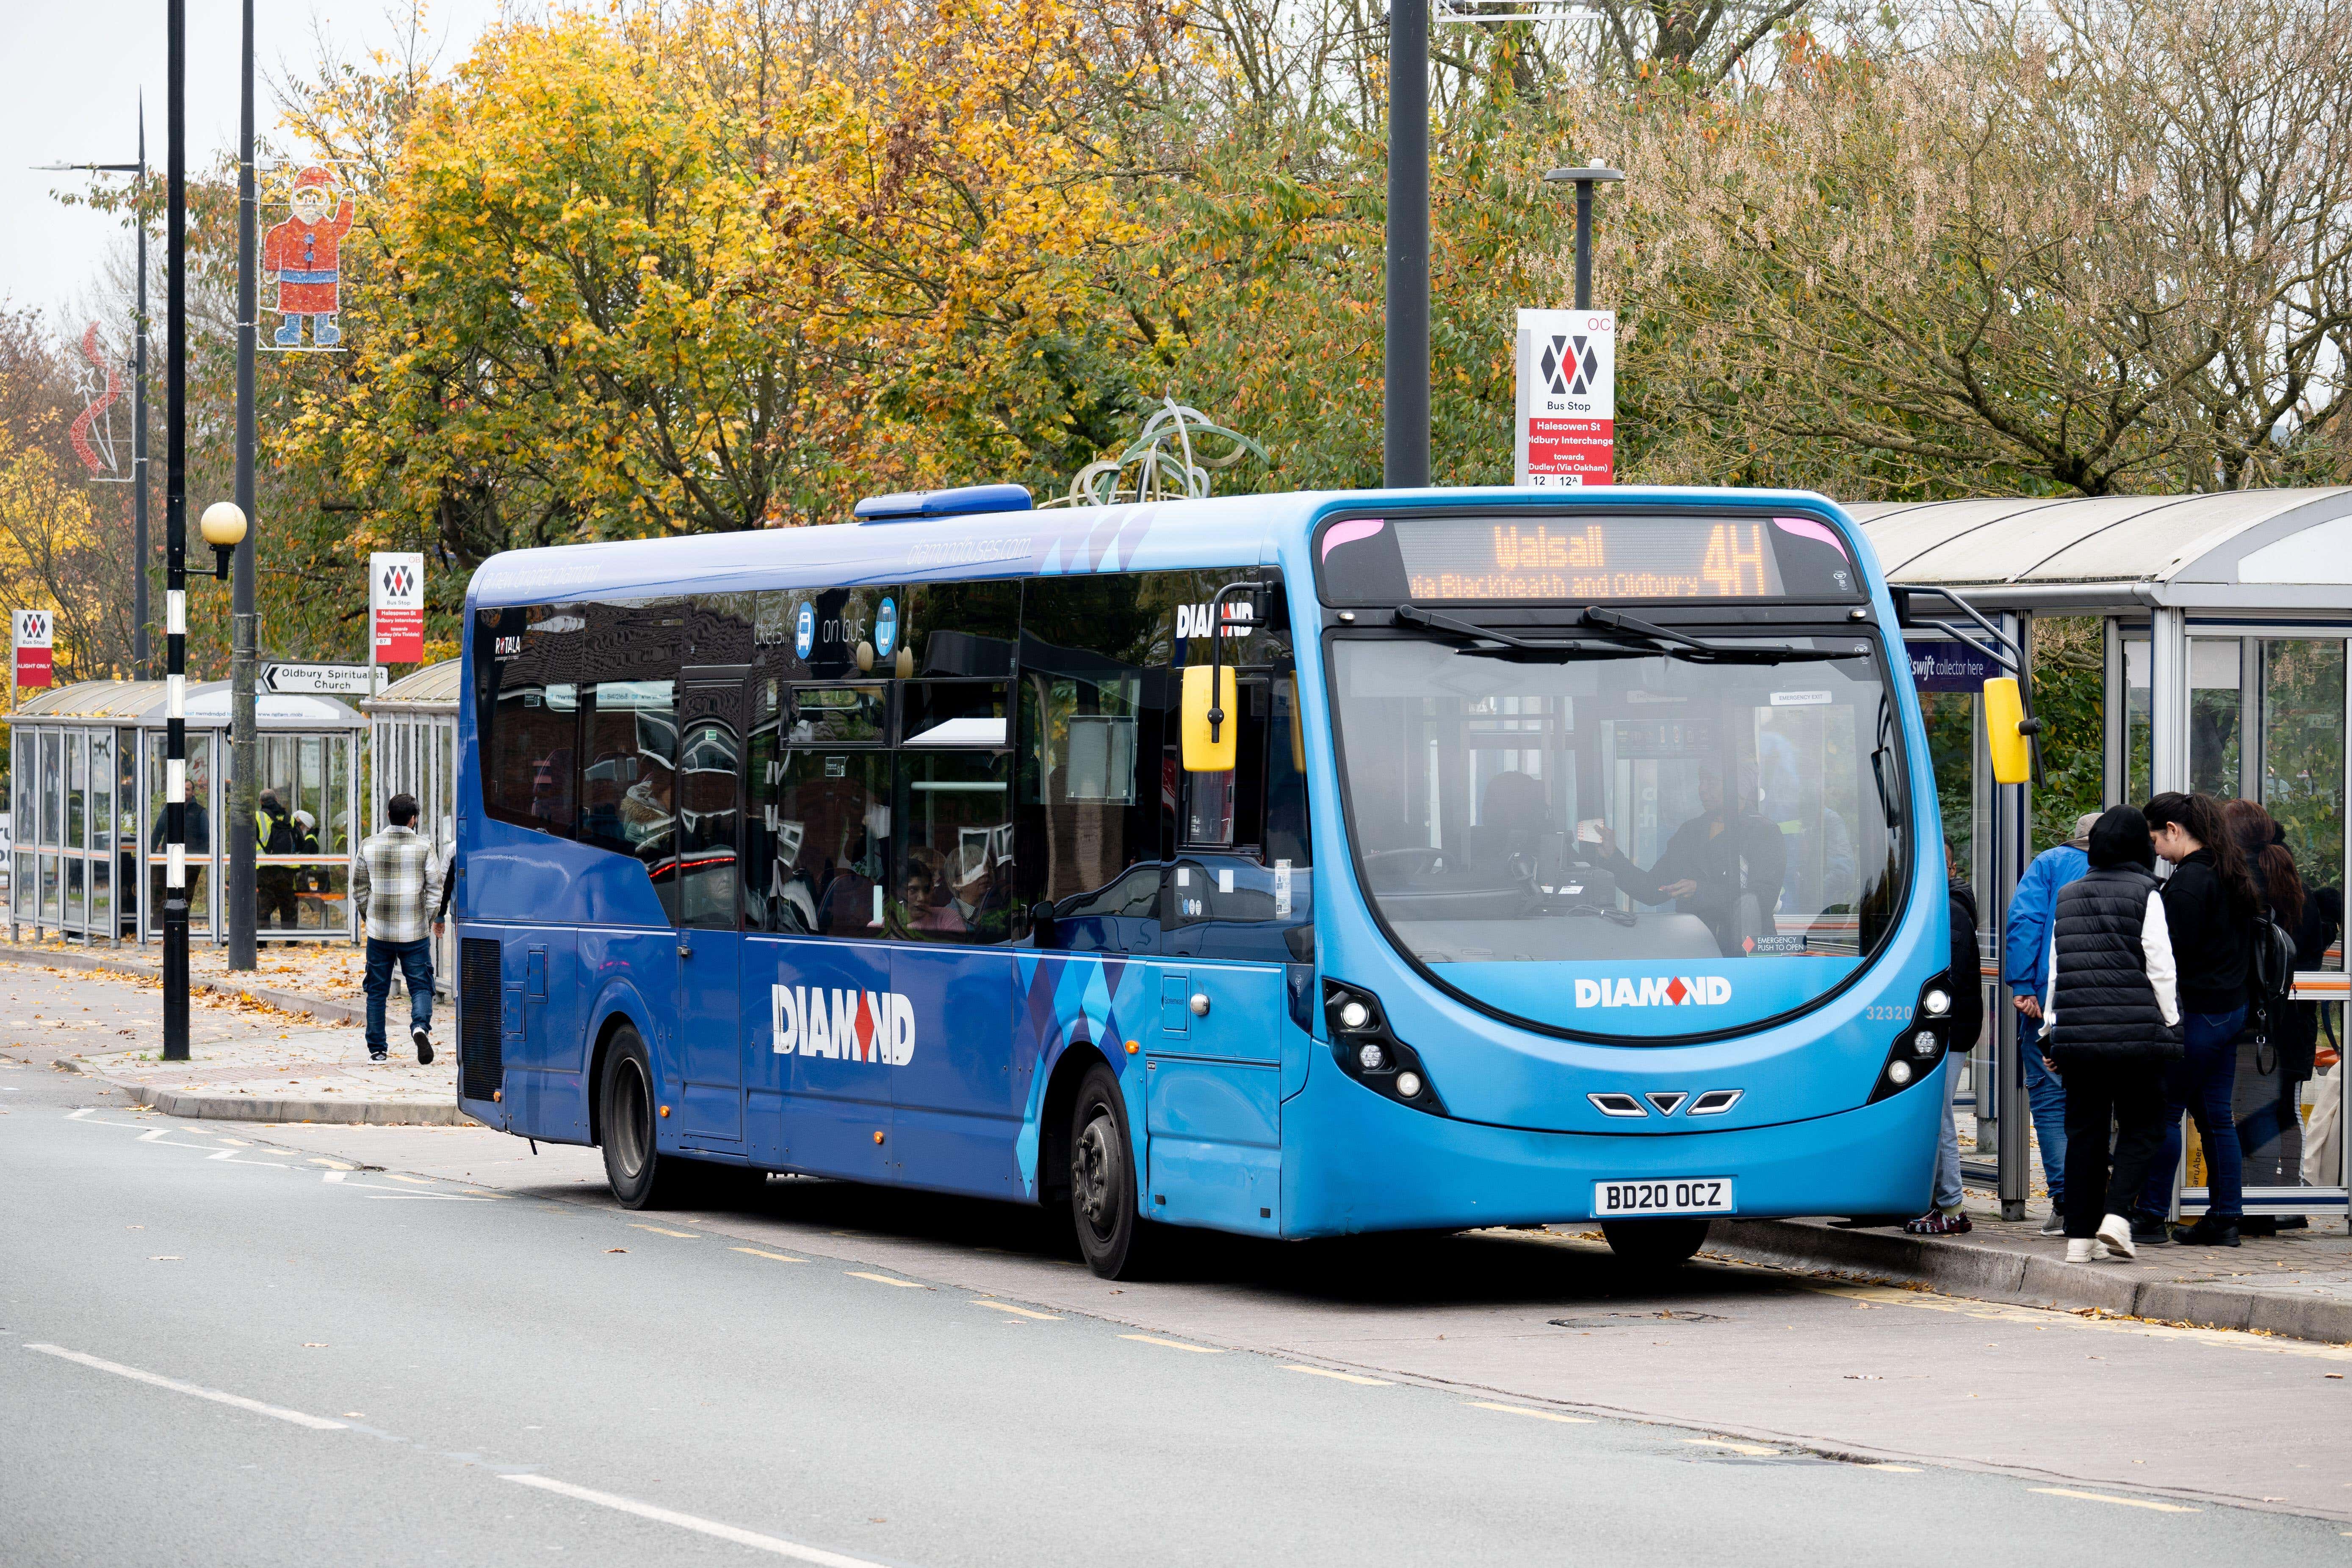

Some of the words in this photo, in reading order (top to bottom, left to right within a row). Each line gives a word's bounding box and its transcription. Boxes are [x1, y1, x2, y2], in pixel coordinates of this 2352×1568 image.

[1588, 318, 1610, 330] OC
[1547, 401, 1565, 410] Bus
[1568, 401, 1591, 412] Stop
[1537, 421, 1588, 431] Halesowen
[1590, 422, 1601, 431] St
[1529, 435, 1559, 446] ldbury
[1561, 436, 1613, 447] Interchange
[1529, 463, 1555, 472] Dudley
[1557, 463, 1572, 472] (Via
[1574, 464, 1608, 473] Oakham)
[1533, 476, 1545, 485] 12
[1559, 477, 1577, 486] 12A
[907, 535, 1032, 565] diamondbuses.com
[1495, 525, 1604, 567] Walsall
[1703, 525, 1764, 595] 4H
[1441, 574, 1566, 597] Blackheath
[1572, 574, 1609, 596] and
[1615, 573, 1699, 595] Oldbury
[823, 619, 838, 643] on
[842, 612, 866, 643] bus
[495, 636, 520, 655] ROTALA
[1912, 655, 1934, 681] swift
[1936, 658, 1966, 675] collector
[1967, 658, 1983, 675] here
[282, 669, 322, 678] Oldbury
[328, 670, 384, 680] Spiritualst
[314, 680, 351, 689] Church
[1165, 996, 1185, 1005] Screenwash
[1866, 1006, 1912, 1020] 32320
[2191, 1147, 2202, 1187] aruAber
[1606, 1184, 1668, 1209] BD20
[1676, 1183, 1721, 1207] OCZ
